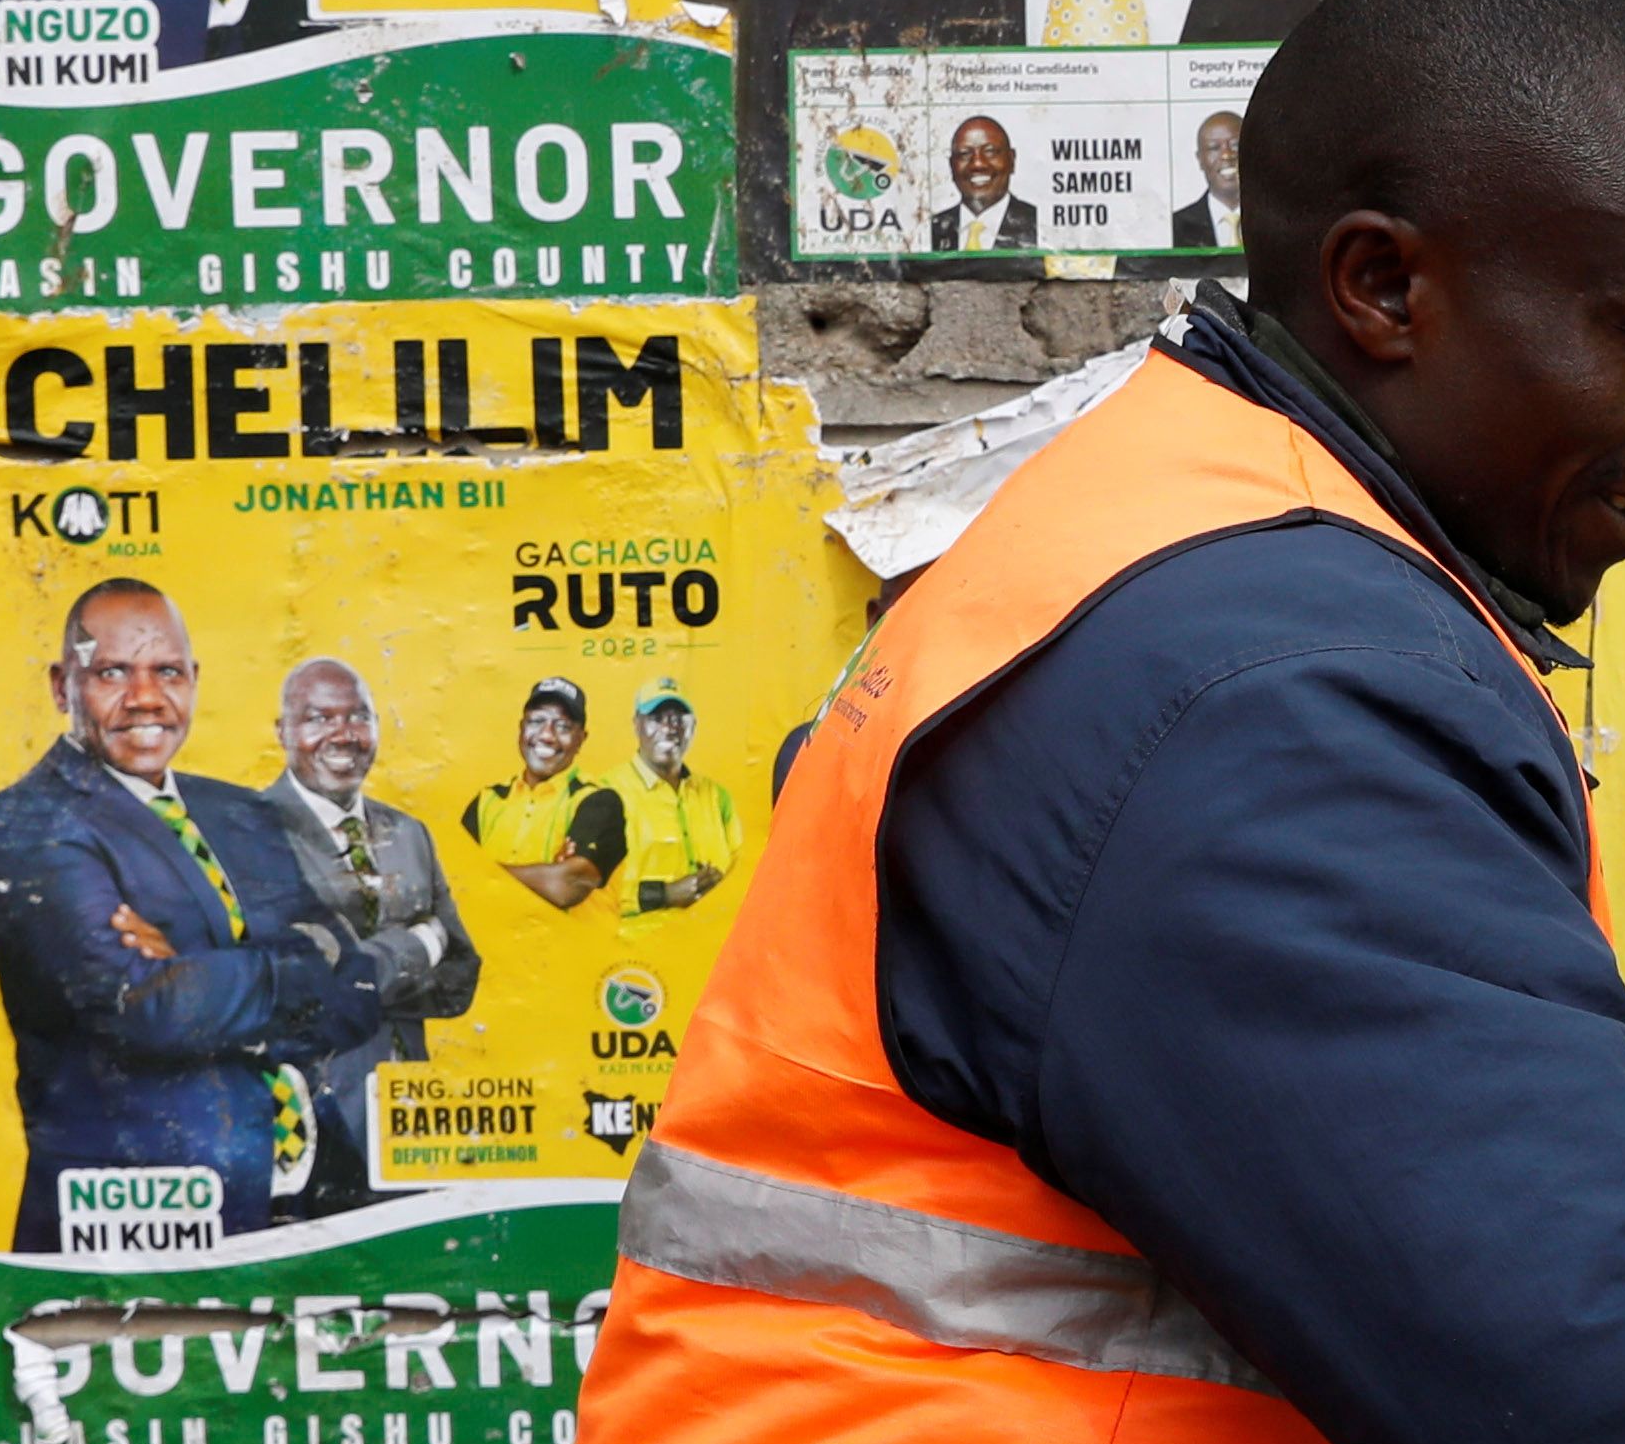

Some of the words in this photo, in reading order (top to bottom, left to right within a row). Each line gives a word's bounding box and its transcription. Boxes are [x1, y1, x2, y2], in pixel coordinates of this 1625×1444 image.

[6, 7, 150, 44] NGUZO
[55, 52, 149, 85] KUMI
[945, 63, 1022, 76] Presidential
[1026, 62, 1099, 76] Candidate's
[1190, 60, 1231, 75] Deputy
[988, 79, 1010, 92] and
[1013, 80, 1058, 92] Names
[1051, 139, 1142, 161] WILLIAM
[1052, 172, 1132, 194] SAMOEI
[819, 208, 903, 232] UDA
[1053, 204, 1109, 226] RUTO
[199, 250, 391, 295] GISHU
[449, 244, 688, 290] COUNTY
[5, 334, 683, 461] CHELILIM
[235, 484, 443, 512] JONATHAN
[458, 479, 505, 508] BII
[107, 542, 163, 556] MOJA
[515, 537, 718, 568] GACHAGUA
[512, 570, 720, 632] RUTO
[465, 1078, 534, 1097] JOHN
[390, 1105, 537, 1135] BAROROT
[392, 1146, 450, 1164] DEPUTY
[73, 1222, 109, 1253] NI
[122, 1221, 213, 1251] KUMI
